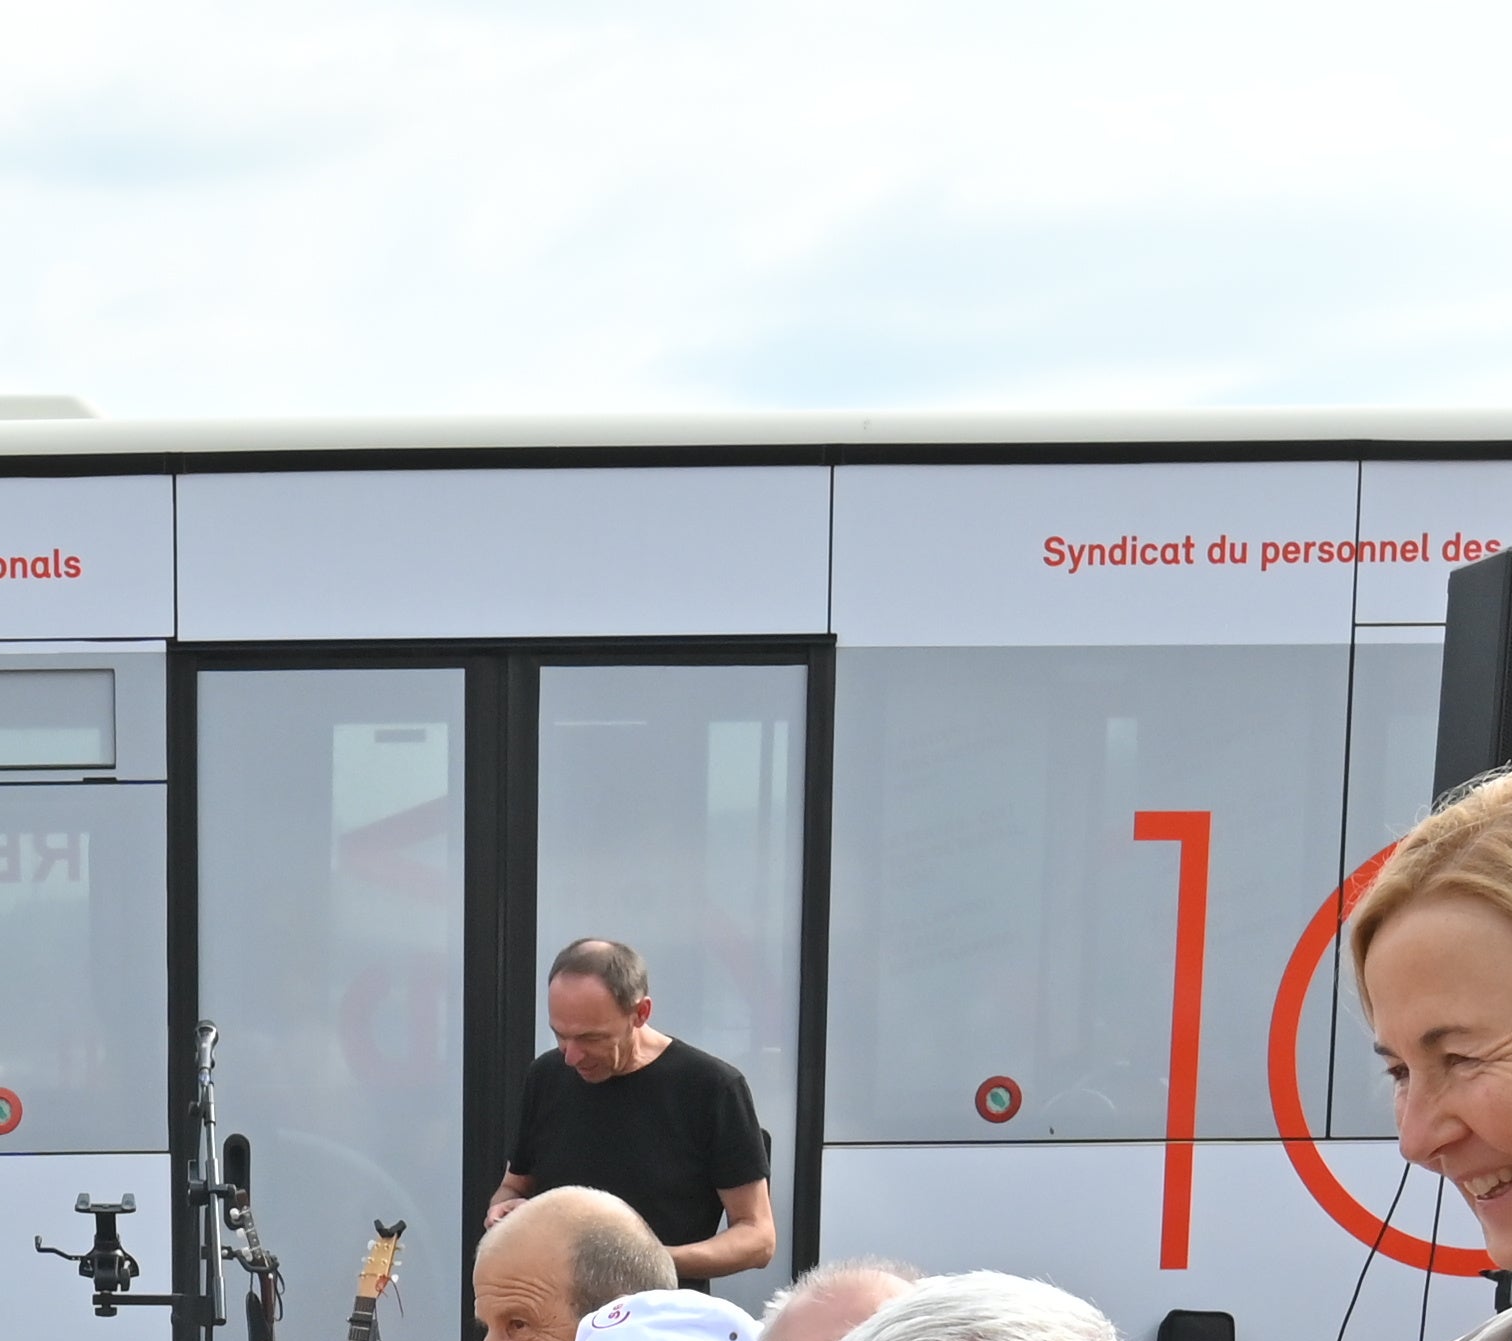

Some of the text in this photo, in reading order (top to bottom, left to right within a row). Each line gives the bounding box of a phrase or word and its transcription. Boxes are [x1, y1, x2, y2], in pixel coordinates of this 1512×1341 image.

[1044, 535, 1197, 574] Syndicat
[1207, 535, 1249, 566] du
[1261, 533, 1431, 572] personnel
[1442, 532, 1502, 564] des
